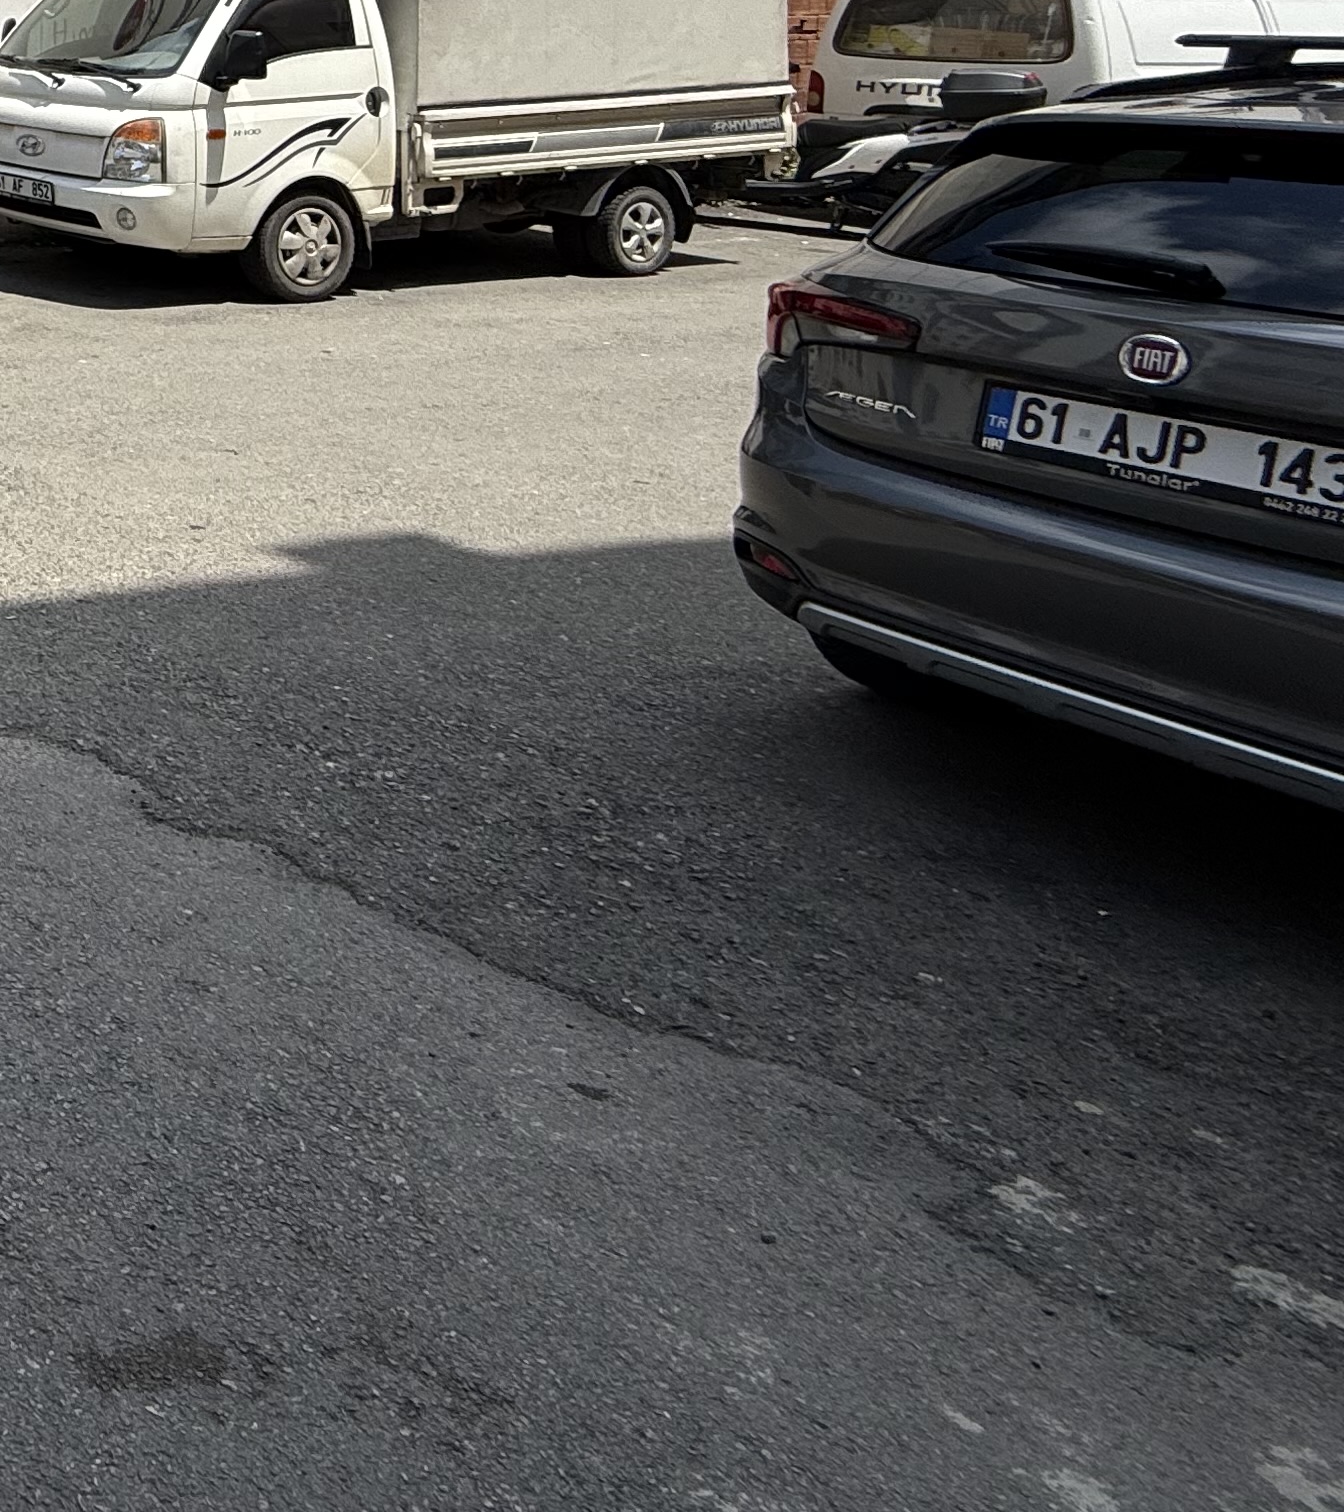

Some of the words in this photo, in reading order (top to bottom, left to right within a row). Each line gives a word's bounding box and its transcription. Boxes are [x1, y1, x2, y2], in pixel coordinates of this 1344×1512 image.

[728, 116, 781, 133] HYUNDAI
[12, 177, 24, 193] AF
[32, 181, 50, 200] 852
[1133, 348, 1174, 374] FIAT
[988, 414, 1009, 429] TR
[1015, 397, 1070, 445] 61
[1097, 412, 1207, 469] AJP
[1258, 440, 1344, 503] 143
